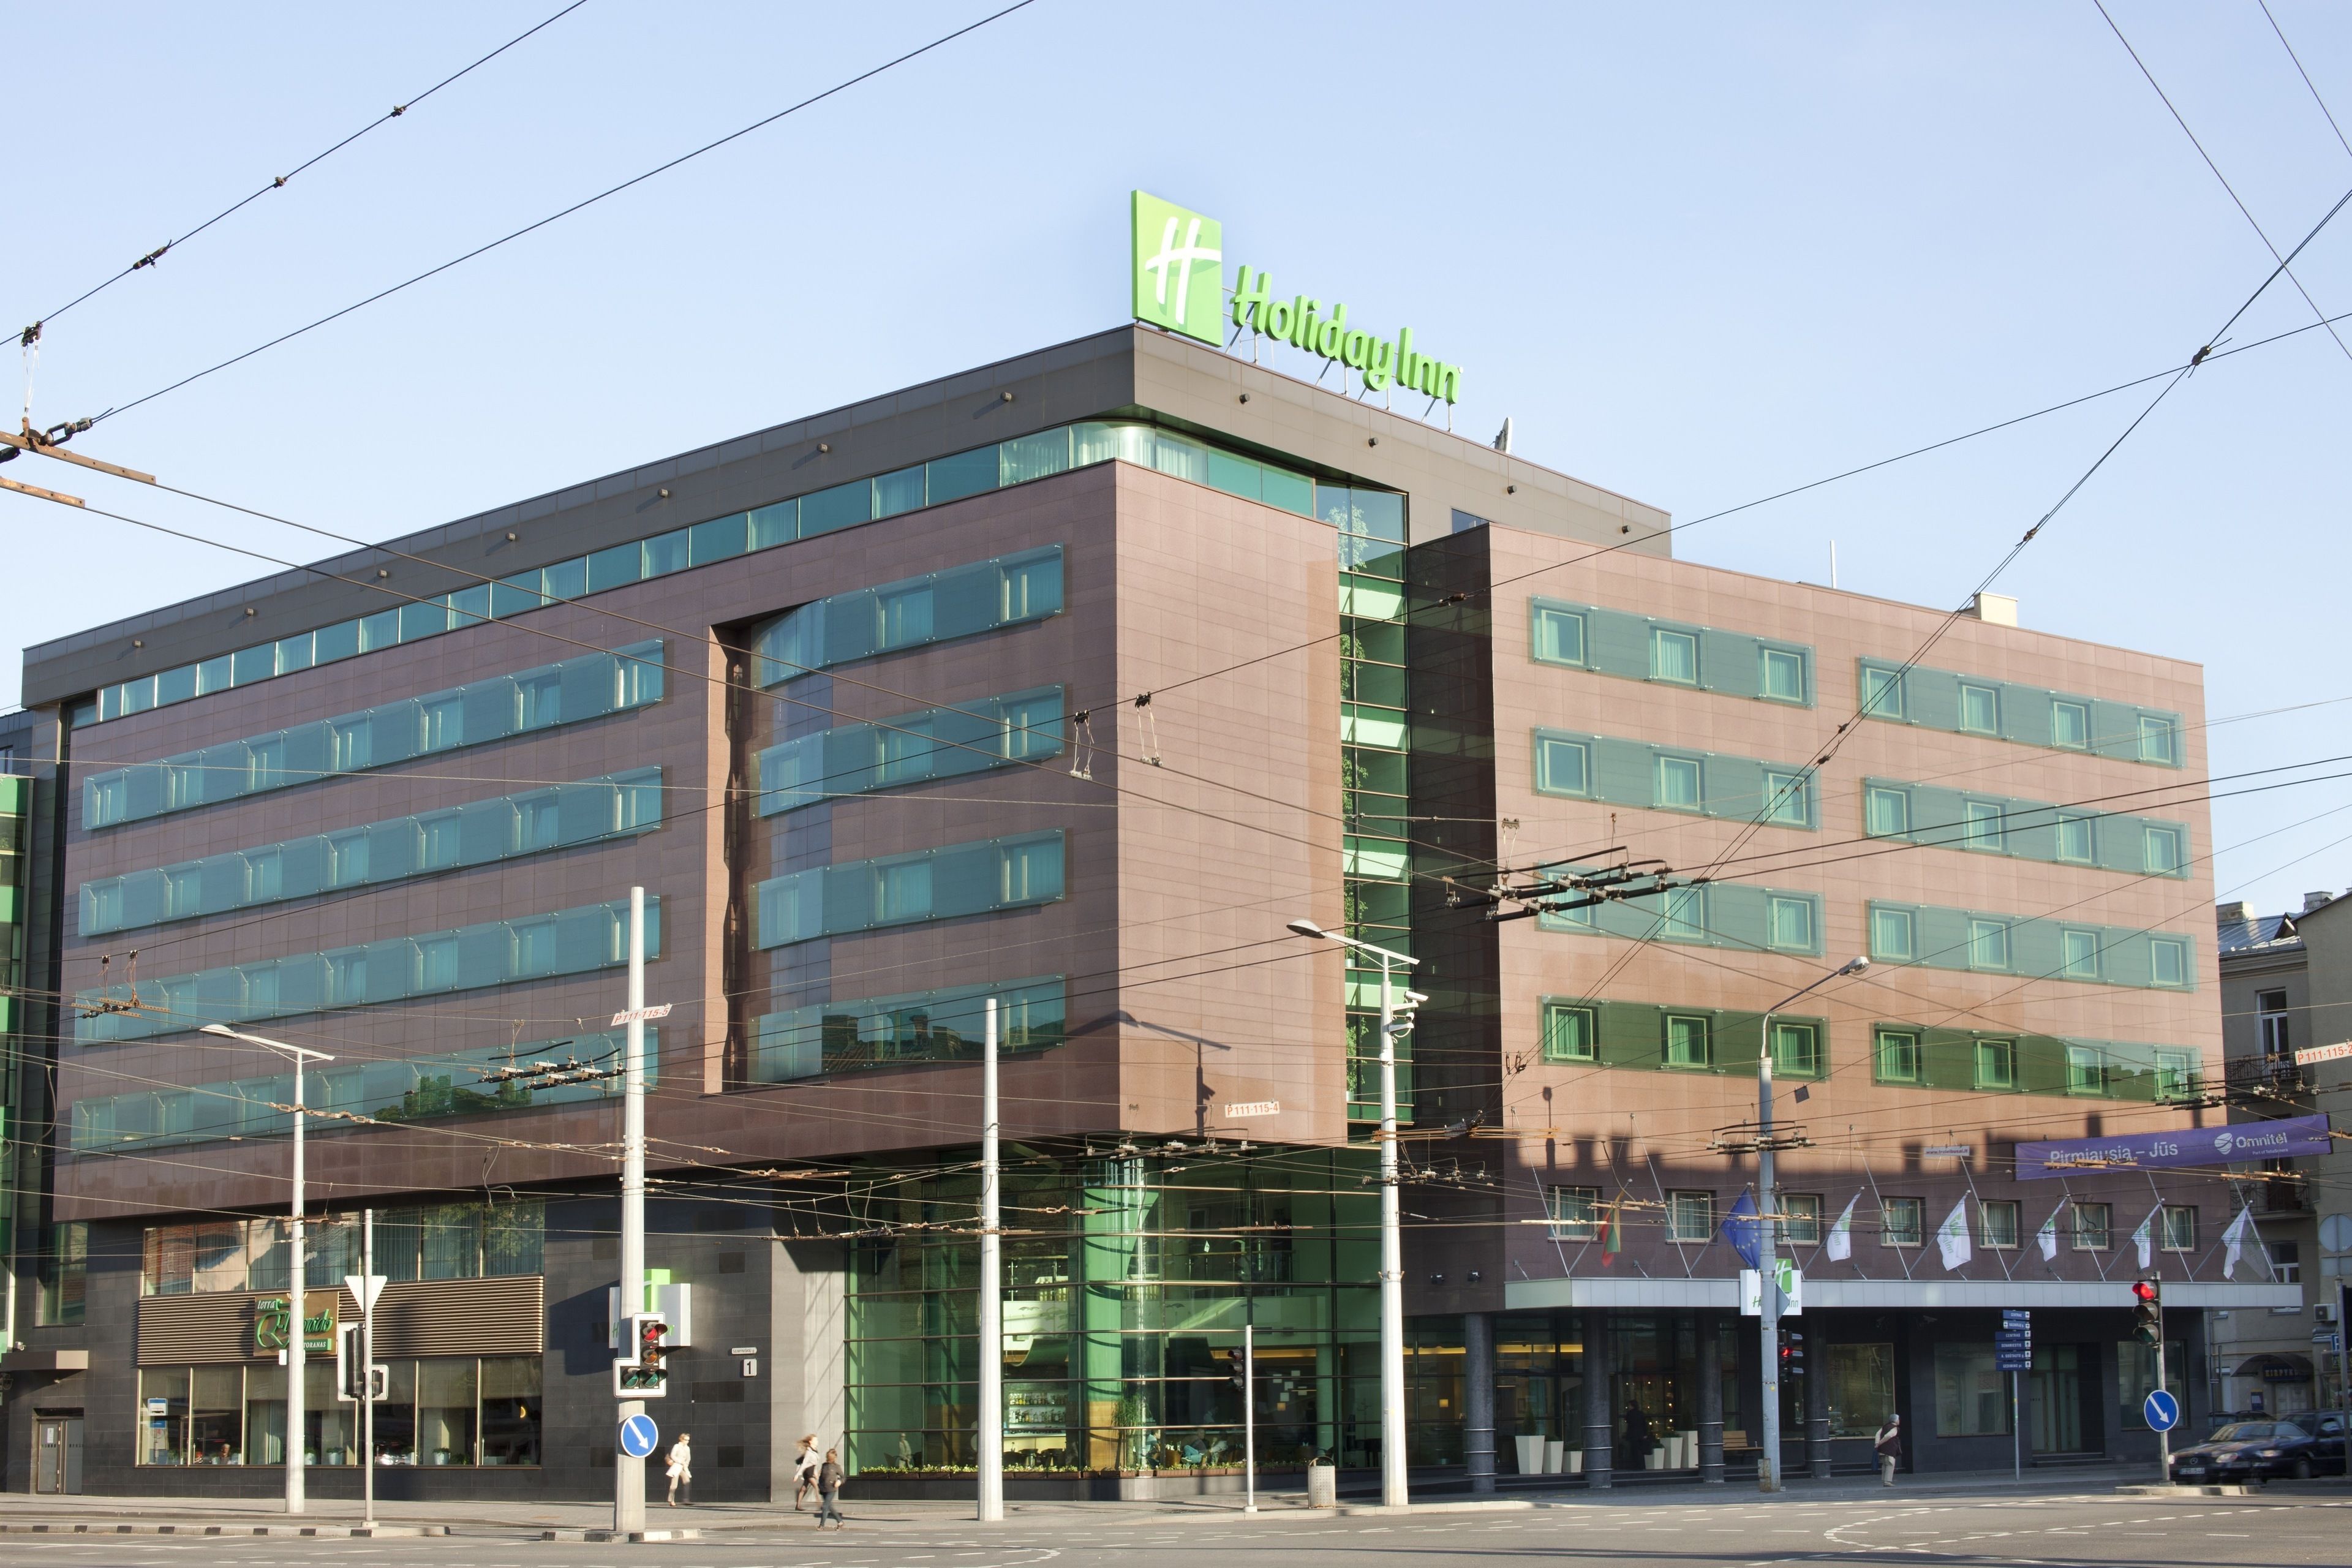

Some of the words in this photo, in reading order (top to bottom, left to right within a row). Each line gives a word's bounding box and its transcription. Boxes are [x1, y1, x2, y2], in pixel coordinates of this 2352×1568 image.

[1229, 265, 1394, 391] Holiday
[1396, 326, 1461, 404] Inn
[2236, 1132, 2288, 1148] Omnitel
[2149, 1142, 2179, 1158] Jūs
[257, 1300, 276, 1310] terra
[747, 1361, 751, 1374] 1
